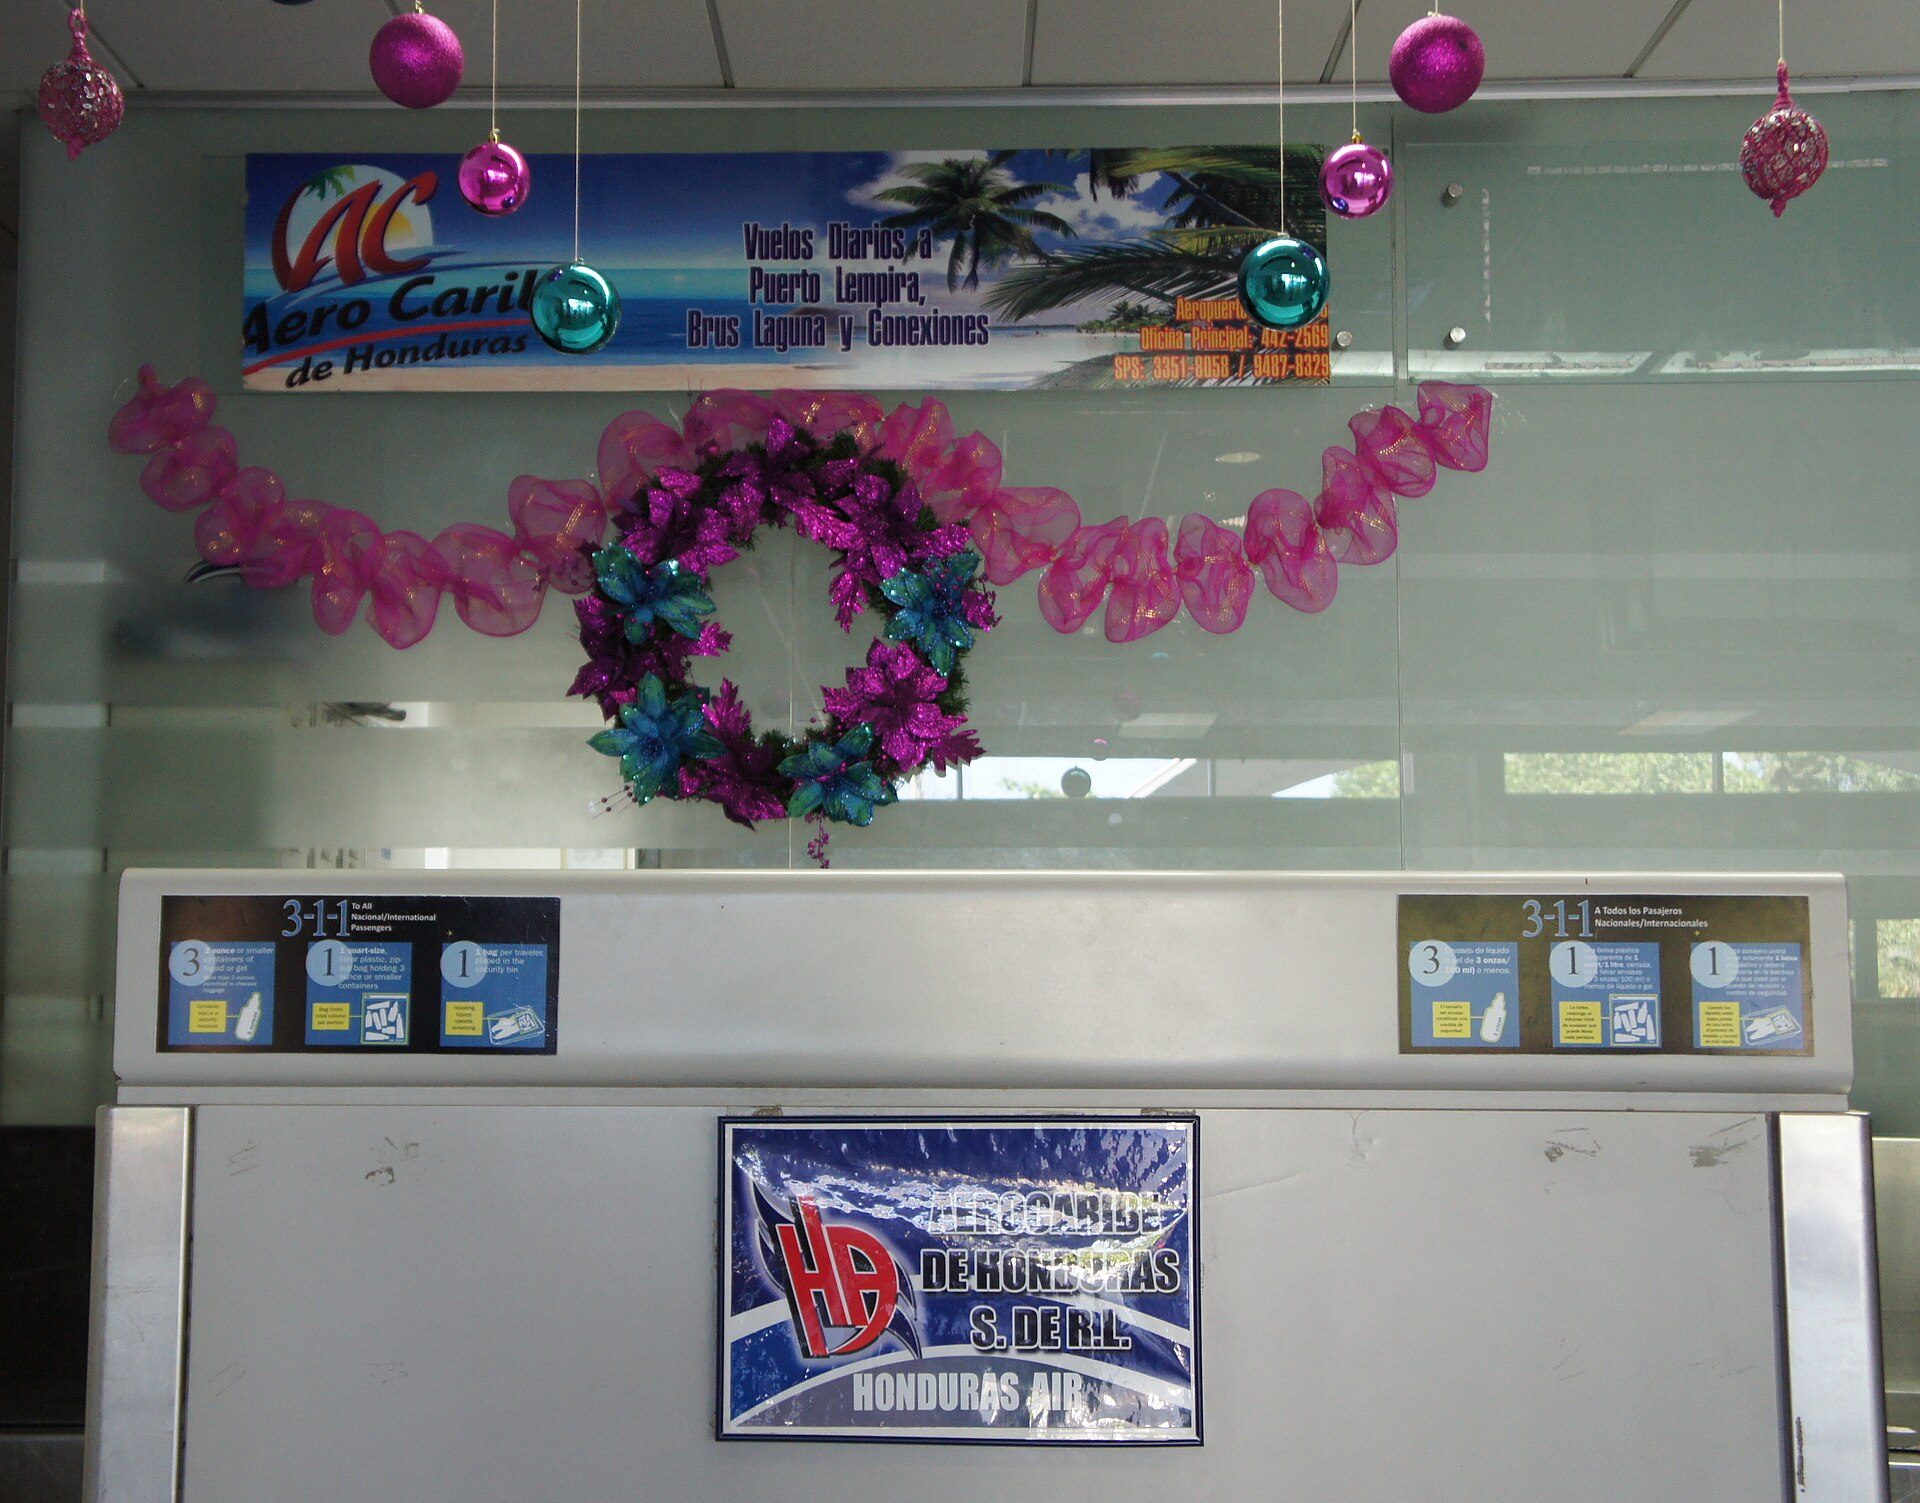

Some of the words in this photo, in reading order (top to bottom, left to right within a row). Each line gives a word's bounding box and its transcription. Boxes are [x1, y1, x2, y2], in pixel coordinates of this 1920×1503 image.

[743, 222, 814, 261] Vuelos
[828, 221, 906, 261] Diarios
[919, 228, 933, 260] a
[749, 266, 821, 304] Puerto
[835, 266, 927, 308] Lempira,
[242, 299, 371, 354] Aero
[388, 270, 532, 322] Cari
[687, 309, 740, 348] Brus
[753, 309, 826, 353] Laguna
[839, 316, 854, 352] y
[867, 308, 989, 348] Conexiones
[1140, 326, 1185, 350] Oficina
[1190, 325, 1254, 351] Principal:
[285, 357, 333, 388] de
[343, 333, 528, 374] Honduras
[1113, 354, 1146, 380] SPS:
[282, 899, 350, 937] 3-1-1
[351, 902, 361, 910] To
[361, 902, 372, 910] All
[351, 912, 436, 922] Nacional/International
[1522, 899, 1594, 938] 3-1-1
[1594, 907, 1601, 915] A
[1603, 907, 1627, 915] Todos
[1629, 906, 1641, 915] los
[1643, 907, 1683, 917] Pasajeros
[351, 924, 392, 932] Passengers
[1595, 919, 1708, 928] Nacionales/Internacionales
[183, 948, 200, 976] 3
[323, 948, 334, 976] 1
[458, 949, 469, 977] 1
[1423, 945, 1440, 975] 3
[1568, 946, 1579, 975] 1
[1707, 947, 1719, 976] 1
[920, 1248, 969, 1293] DE
[974, 1248, 1181, 1293] HONDURAS
[970, 1305, 1006, 1350] S.
[1010, 1305, 1063, 1349] DE
[1066, 1306, 1132, 1351] R.L.
[853, 1372, 1021, 1412] HONDURAS
[1031, 1372, 1086, 1412] AIR
